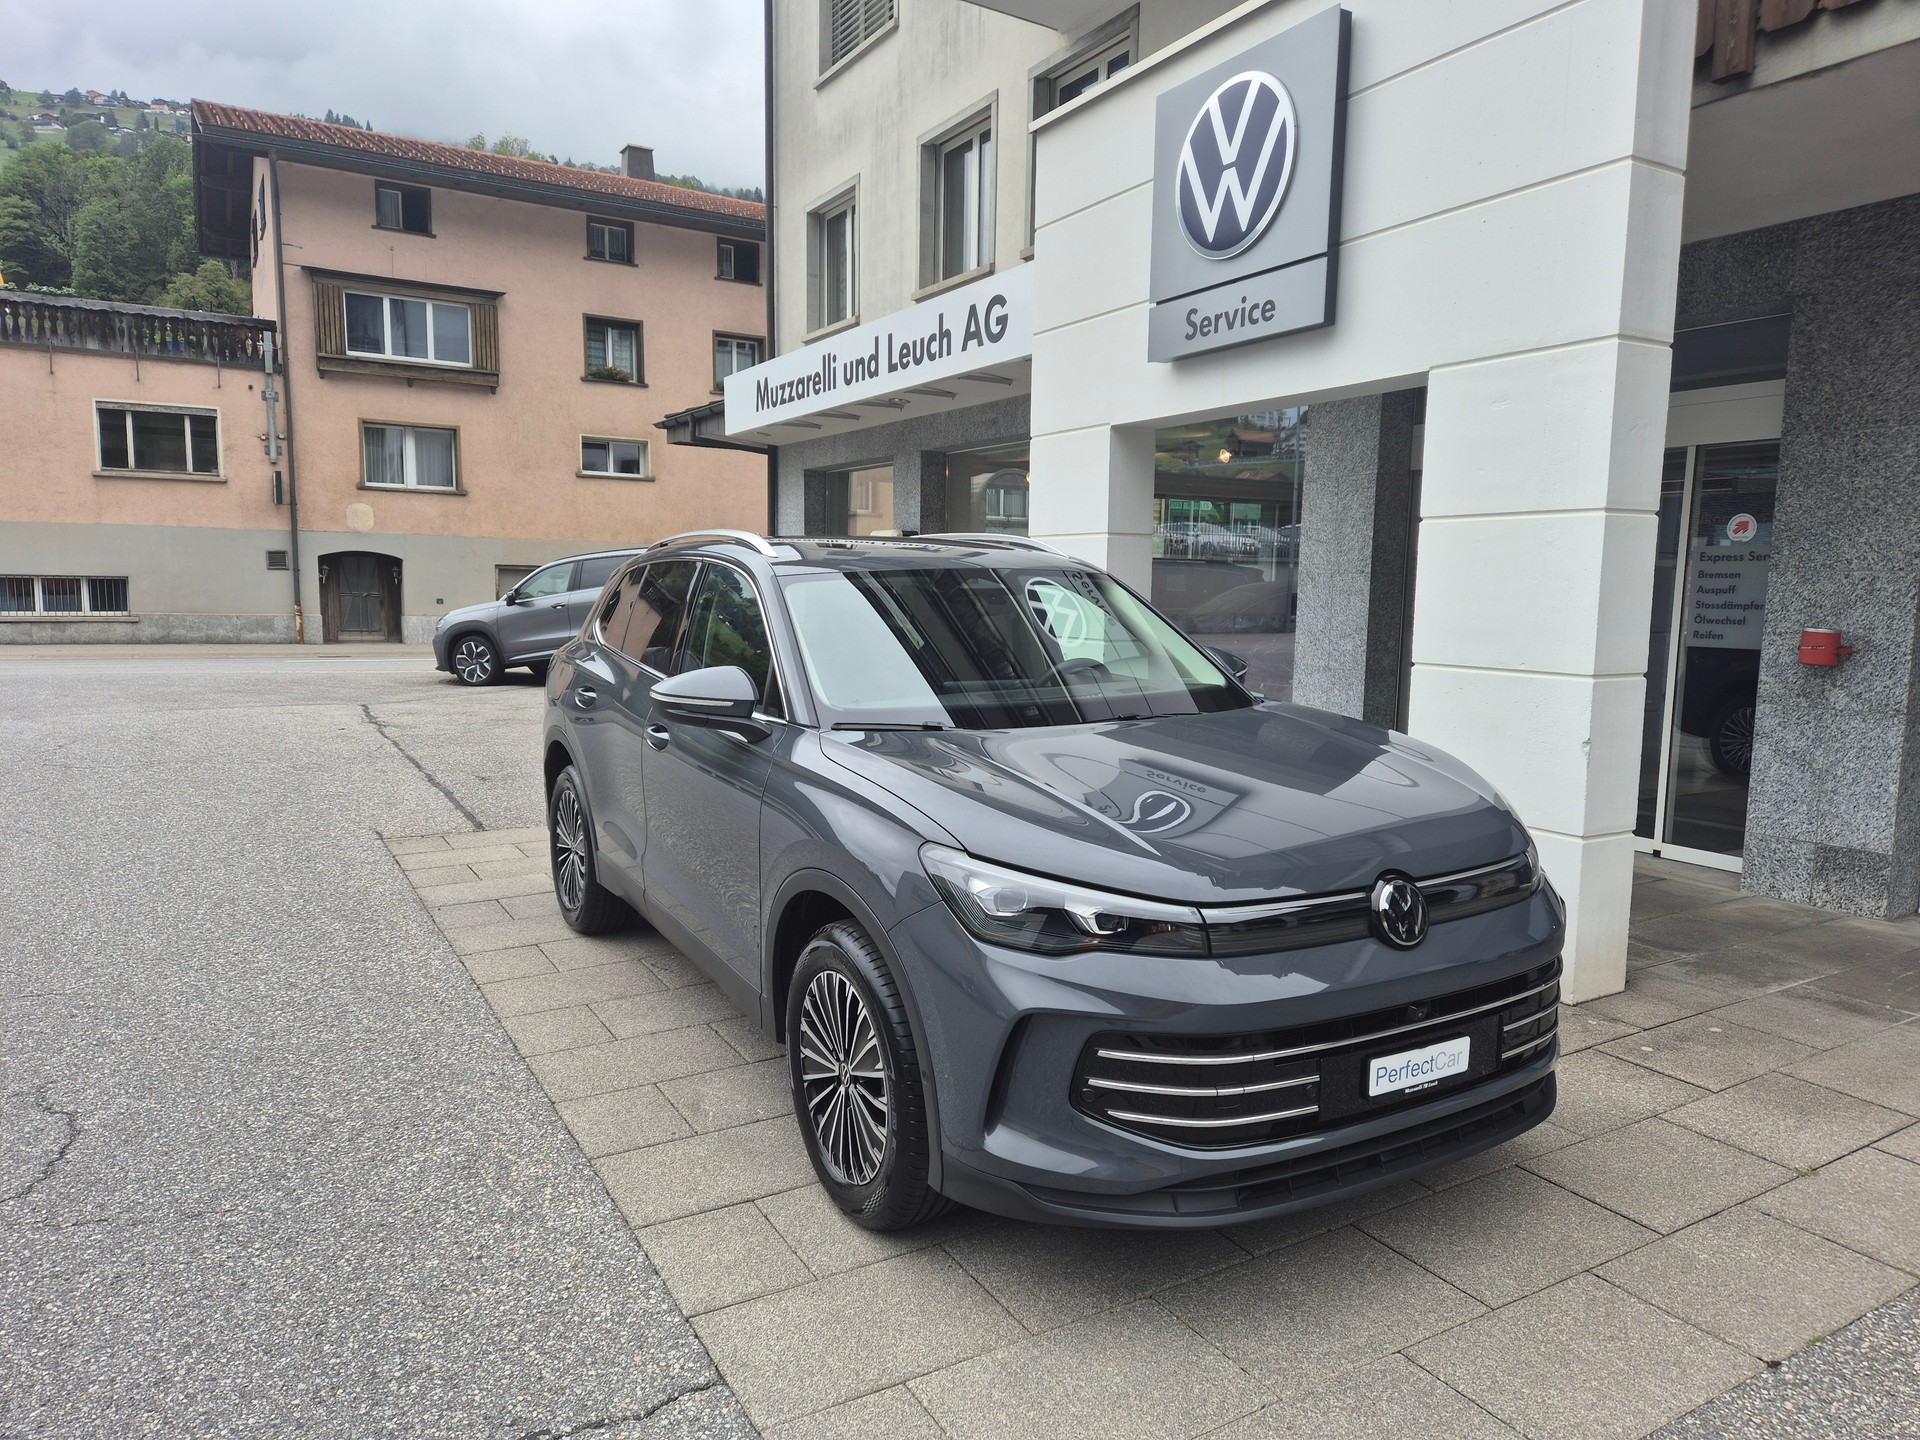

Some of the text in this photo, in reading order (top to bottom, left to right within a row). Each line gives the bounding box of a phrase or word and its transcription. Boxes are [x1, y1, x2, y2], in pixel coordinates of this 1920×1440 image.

[1177, 74, 1293, 250] VW
[1184, 295, 1276, 341] Service
[756, 294, 1009, 412] Muzzarelli und Leuch AG
[1700, 552, 1744, 564] Express
[1698, 570, 1741, 579] Bremsen
[1696, 585, 1736, 596] Auspuff
[1695, 600, 1765, 612] Stossdämpfer
[1694, 613, 1746, 626] Ölwechsel
[1693, 631, 1723, 640] Reifen
[1376, 1051, 1463, 1087] PerfectCar
